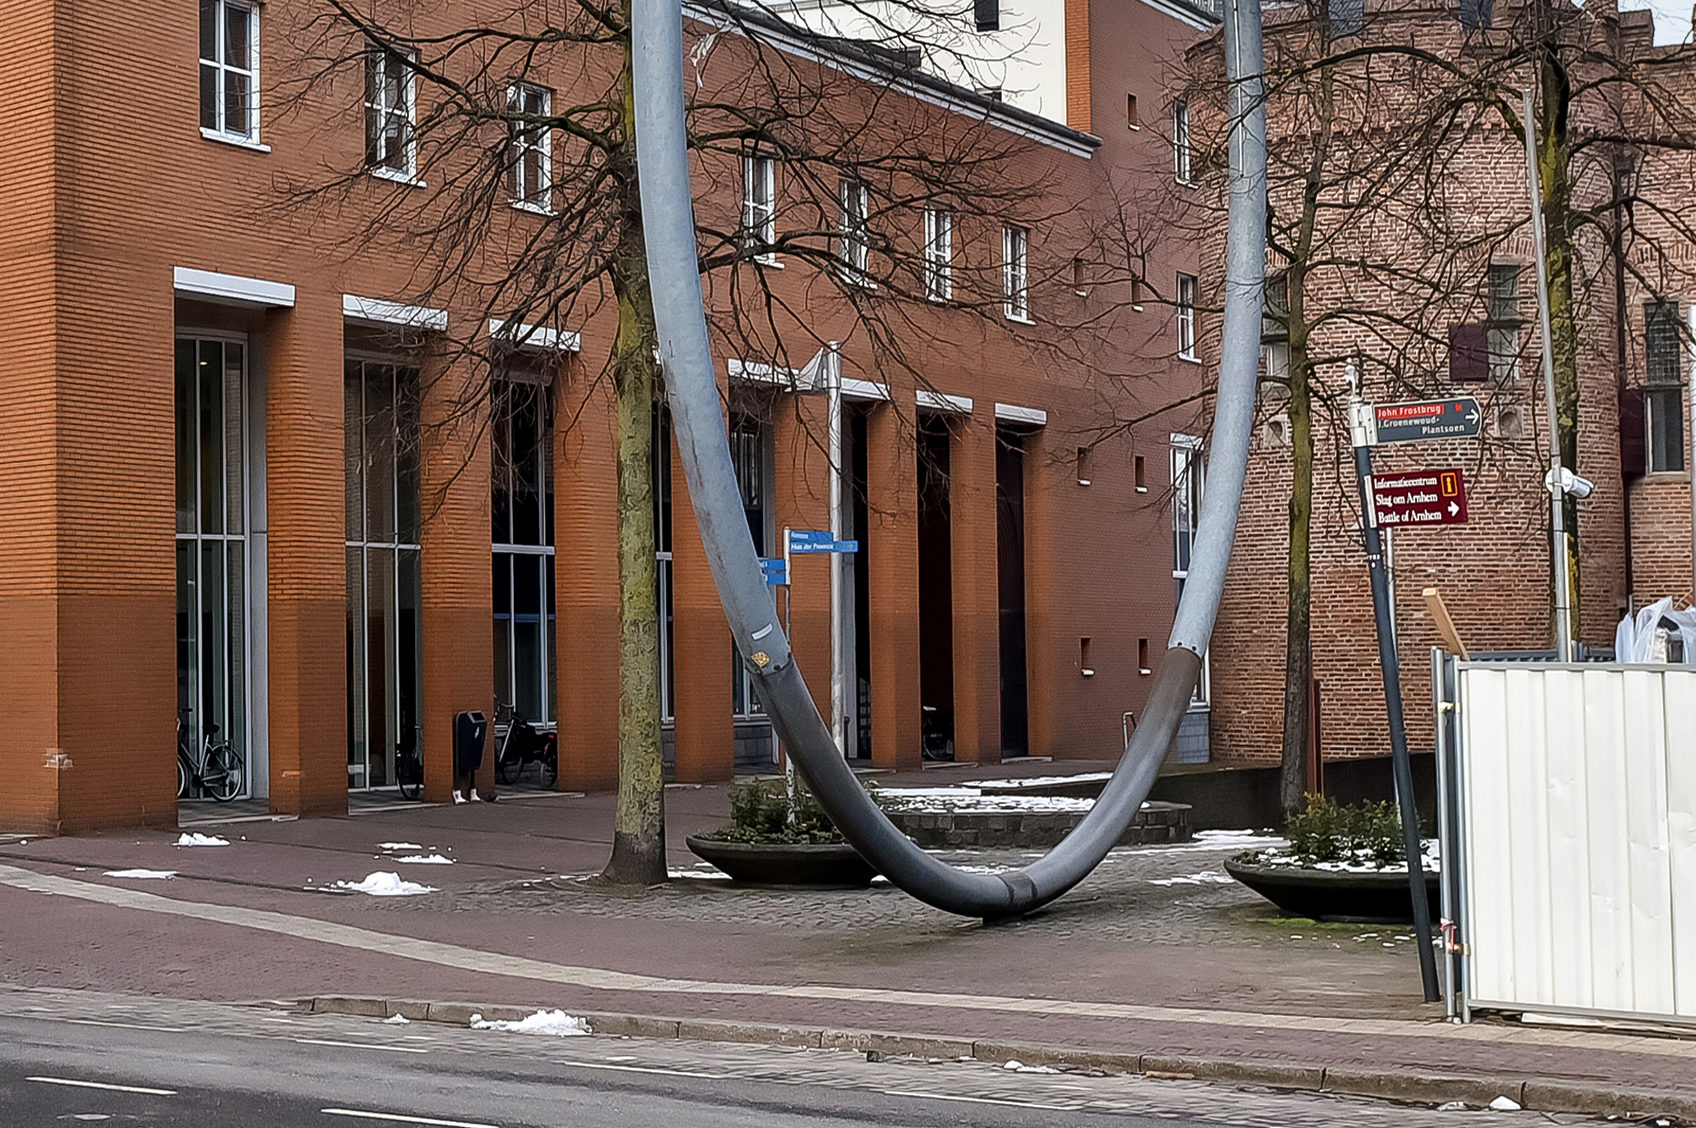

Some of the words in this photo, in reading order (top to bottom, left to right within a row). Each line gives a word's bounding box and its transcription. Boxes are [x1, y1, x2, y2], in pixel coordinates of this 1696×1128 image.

[1378, 408, 1397, 418] John
[1399, 405, 1441, 416] Frostbrug
[1422, 425, 1465, 435] Plantsoen
[1374, 477, 1438, 489] Informatiecentrum
[1375, 493, 1393, 507] Slag
[1393, 496, 1406, 504] om
[1407, 491, 1438, 504] Arnhem
[1378, 511, 1401, 523] Battle
[1401, 510, 1409, 522] of
[1410, 509, 1442, 522] Arnhem
